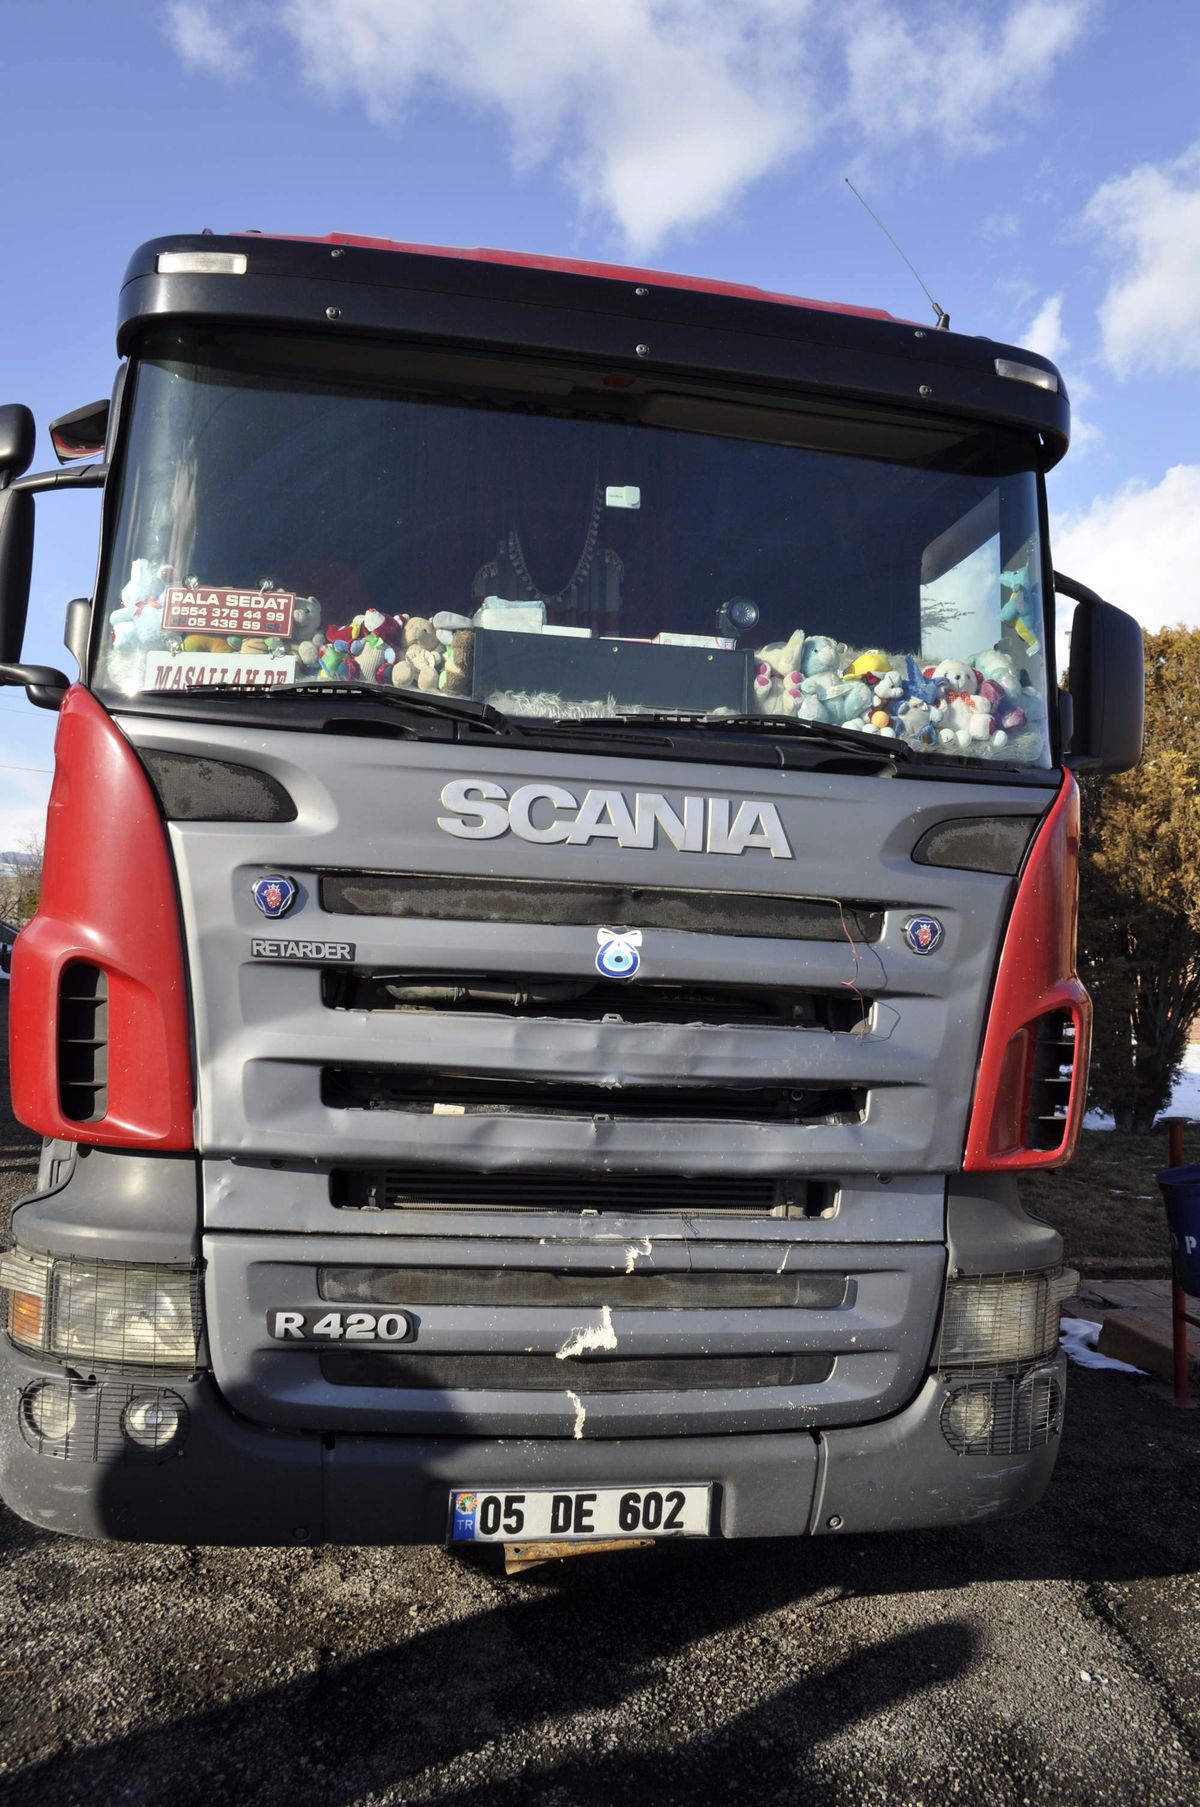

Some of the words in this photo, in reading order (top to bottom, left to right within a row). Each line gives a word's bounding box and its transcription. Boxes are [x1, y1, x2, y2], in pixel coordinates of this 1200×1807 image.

[171, 592, 219, 606] PALA
[225, 594, 289, 610] SEDAT
[171, 606, 208, 617] 0554
[211, 608, 239, 618] 376
[243, 610, 262, 620] 44
[265, 611, 285, 622] 99
[209, 618, 238, 629] 436
[242, 620, 261, 630] 59
[437, 779, 793, 859] SCANIA
[252, 940, 351, 960] RETARDER
[274, 1311, 305, 1339] R
[312, 1312, 408, 1340] 420
[479, 1495, 525, 1535] 05
[550, 1493, 597, 1534] DE
[618, 1490, 686, 1532] 602
[457, 1519, 473, 1530] TR
